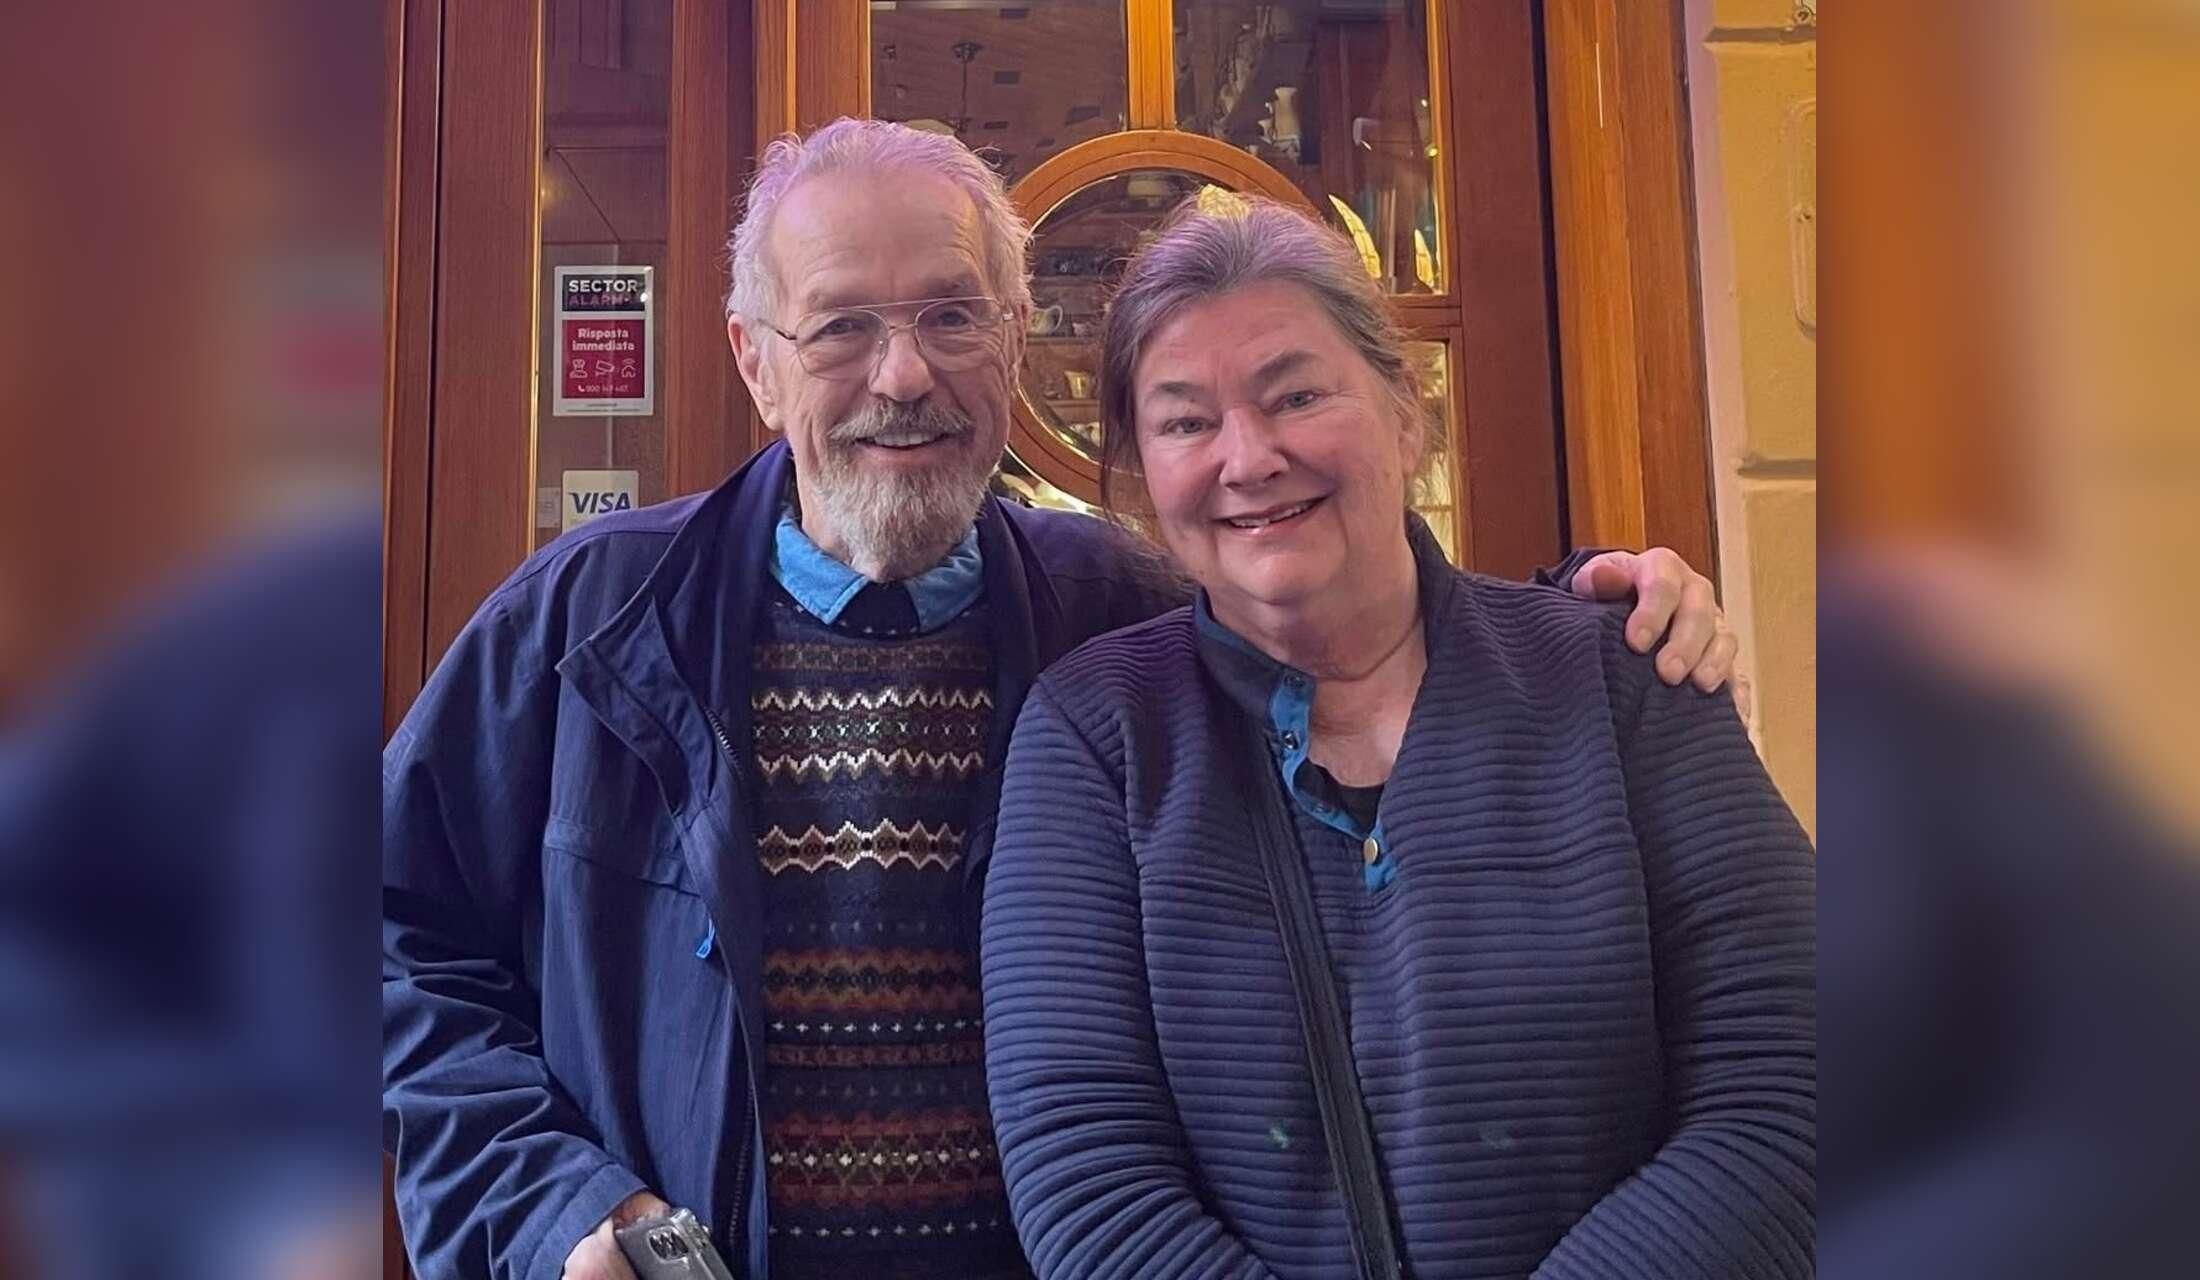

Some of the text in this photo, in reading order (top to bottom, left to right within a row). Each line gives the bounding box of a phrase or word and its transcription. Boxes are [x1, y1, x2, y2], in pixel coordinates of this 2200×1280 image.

[569, 280, 638, 293] SECTOR
[569, 295, 624, 306] ALARM
[578, 328, 629, 340] Risposta
[572, 340, 635, 351] immediata
[569, 492, 631, 513] VISA
